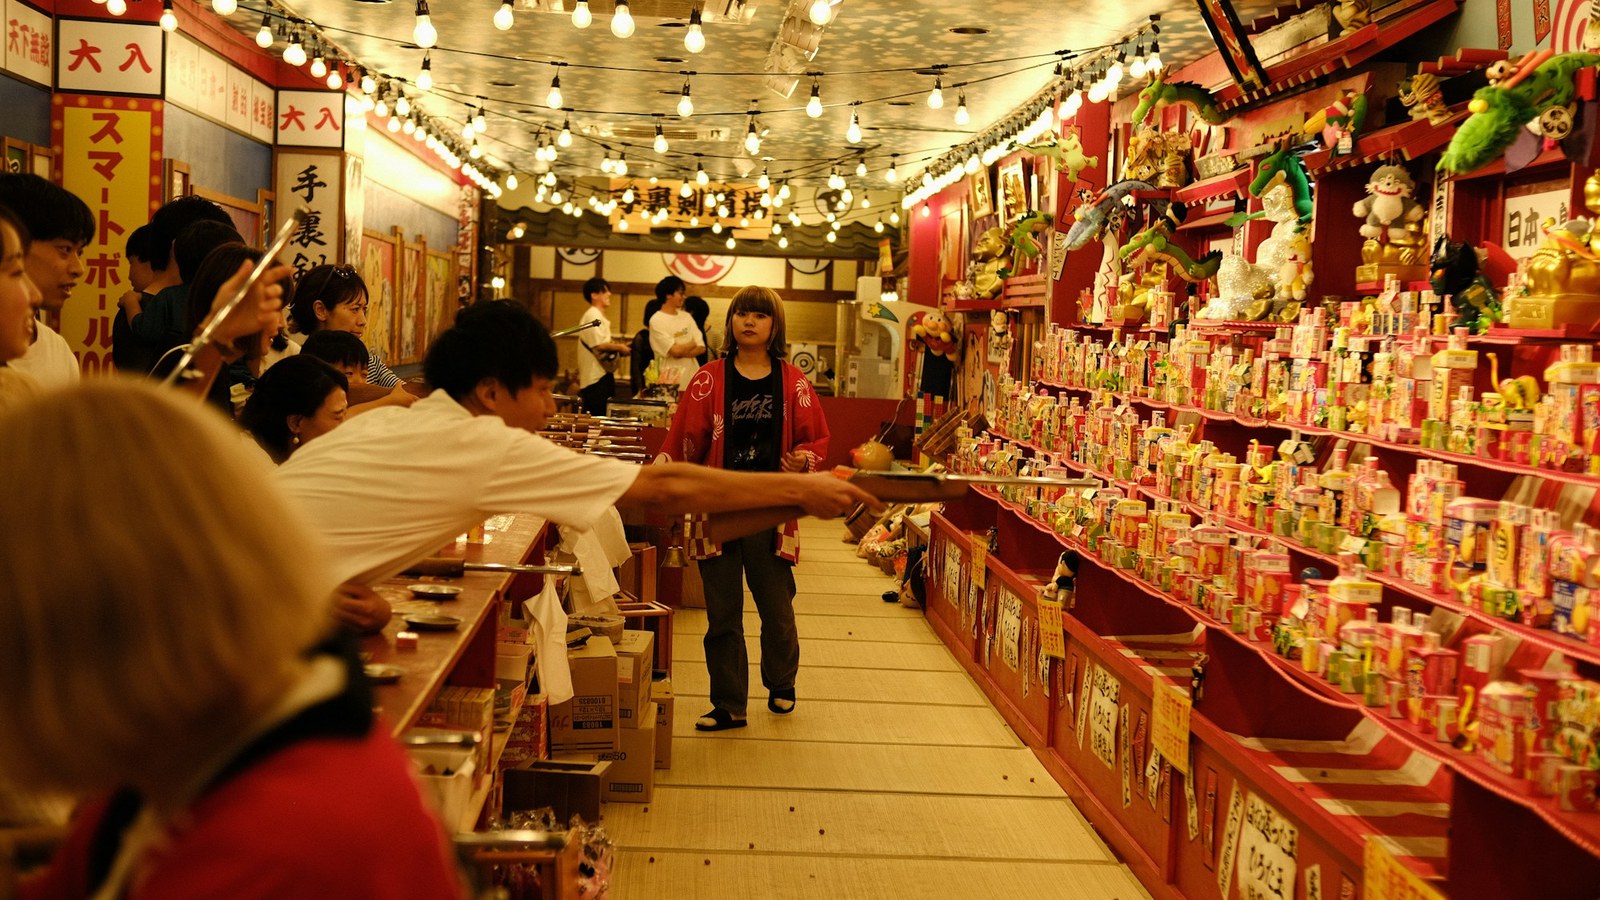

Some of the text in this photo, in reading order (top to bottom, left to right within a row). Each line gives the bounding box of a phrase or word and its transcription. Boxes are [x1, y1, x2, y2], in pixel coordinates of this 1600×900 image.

[67, 38, 153, 74] 大入
[279, 104, 340, 132] 大入
[84, 112, 125, 350] スマートボール
